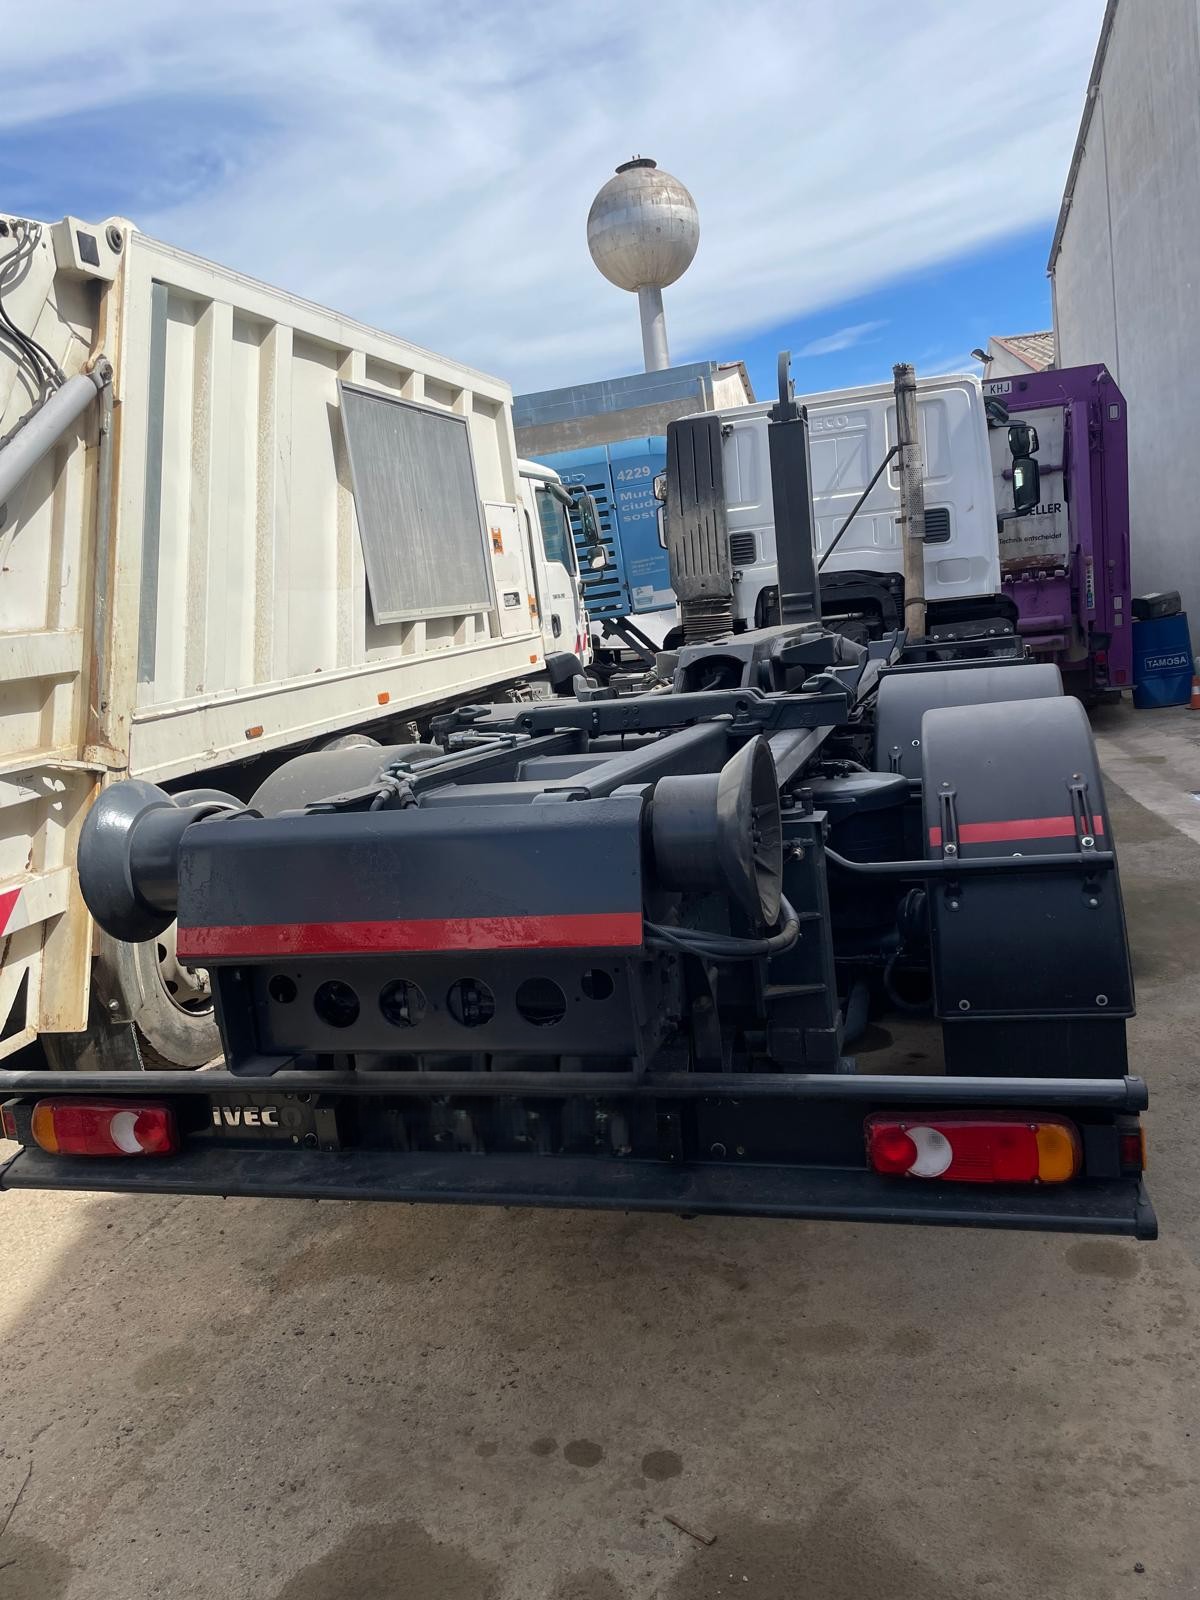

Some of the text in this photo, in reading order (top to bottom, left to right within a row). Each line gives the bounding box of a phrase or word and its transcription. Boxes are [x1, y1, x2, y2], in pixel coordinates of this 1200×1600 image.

[990, 382, 1010, 394] KHJ
[617, 466, 651, 481] 4229
[1028, 502, 1062, 516] ELLER
[1146, 656, 1187, 668] TAMOSA
